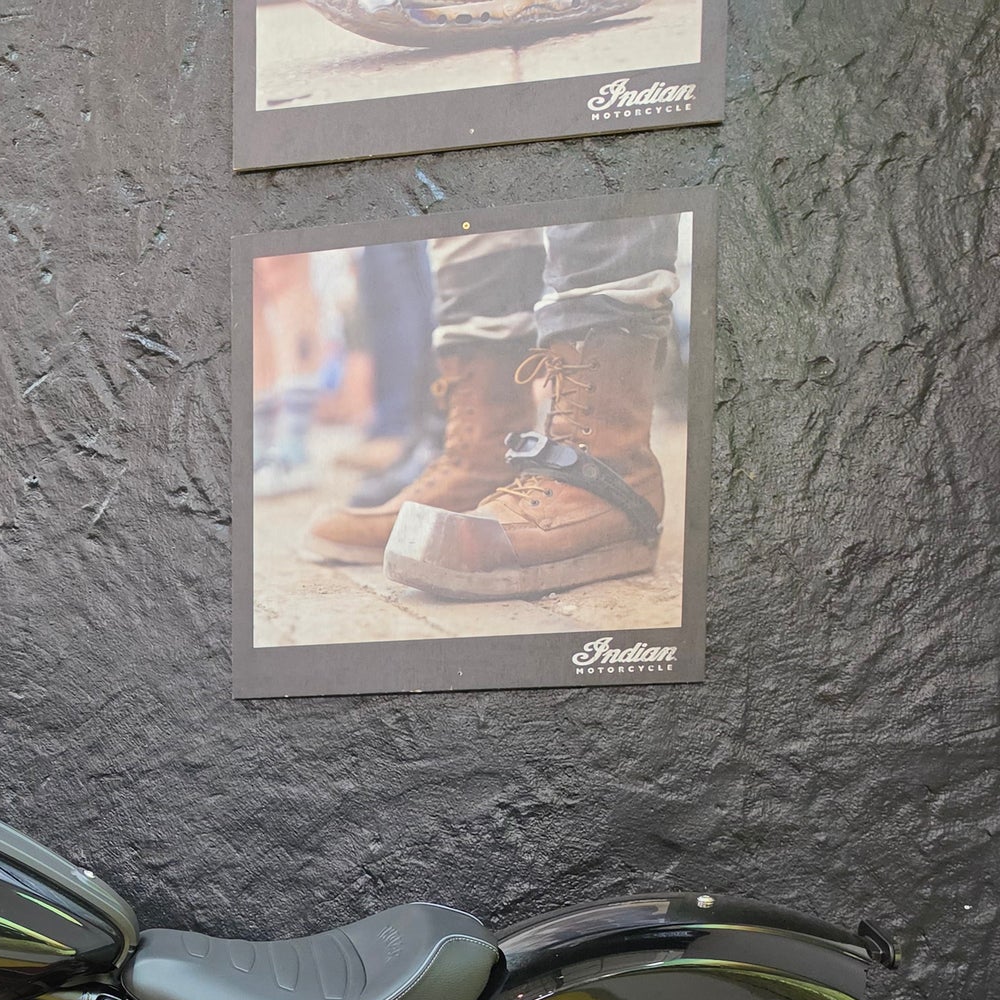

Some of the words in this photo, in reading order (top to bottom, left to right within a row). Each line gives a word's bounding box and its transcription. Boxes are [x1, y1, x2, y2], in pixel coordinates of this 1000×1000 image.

[587, 78, 696, 111] Indian
[591, 103, 692, 121] MOTORCYCLE
[571, 636, 678, 666] Indian
[575, 664, 674, 675] MOTORCYCLE
